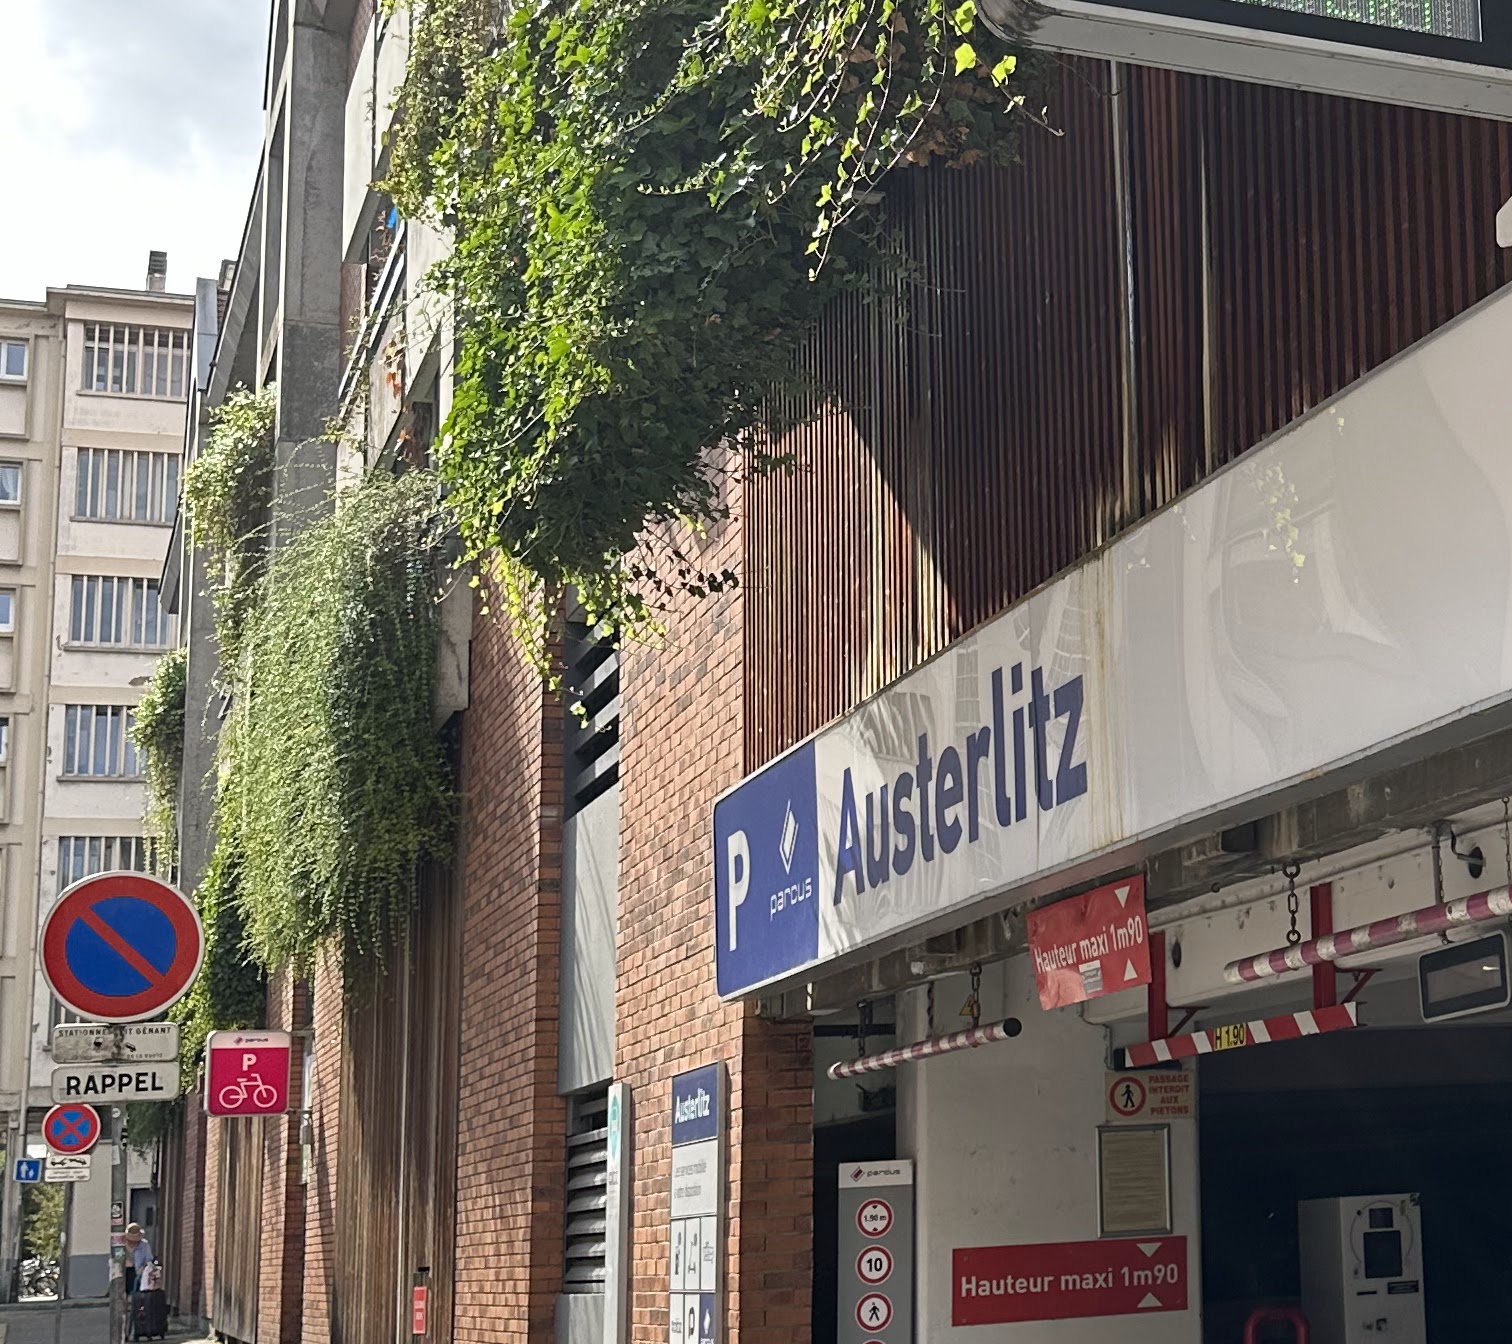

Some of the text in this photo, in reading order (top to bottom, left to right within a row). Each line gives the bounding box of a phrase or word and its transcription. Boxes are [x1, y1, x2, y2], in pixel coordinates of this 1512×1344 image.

[833, 661, 1088, 907] Austerlitz
[728, 829, 751, 952] P
[770, 877, 812, 922] parcus
[1034, 915, 1144, 974] Hauteur maxi 1m90
[58, 1028, 132, 1037] STATIONNET
[1215, 1024, 1244, 1050] H 1.90
[242, 1053, 257, 1071] P
[66, 1071, 164, 1096] RAPPEL
[1149, 1074, 1189, 1083] PASSAGE
[1149, 1085, 1189, 1094] INTERDIT
[675, 1088, 710, 1124] Austerlitz
[1160, 1096, 1179, 1104] AUX
[866, 1169, 901, 1177] parcus
[866, 1258, 883, 1272] 10
[961, 1263, 1179, 1298] Hauteur maxi 1m90
